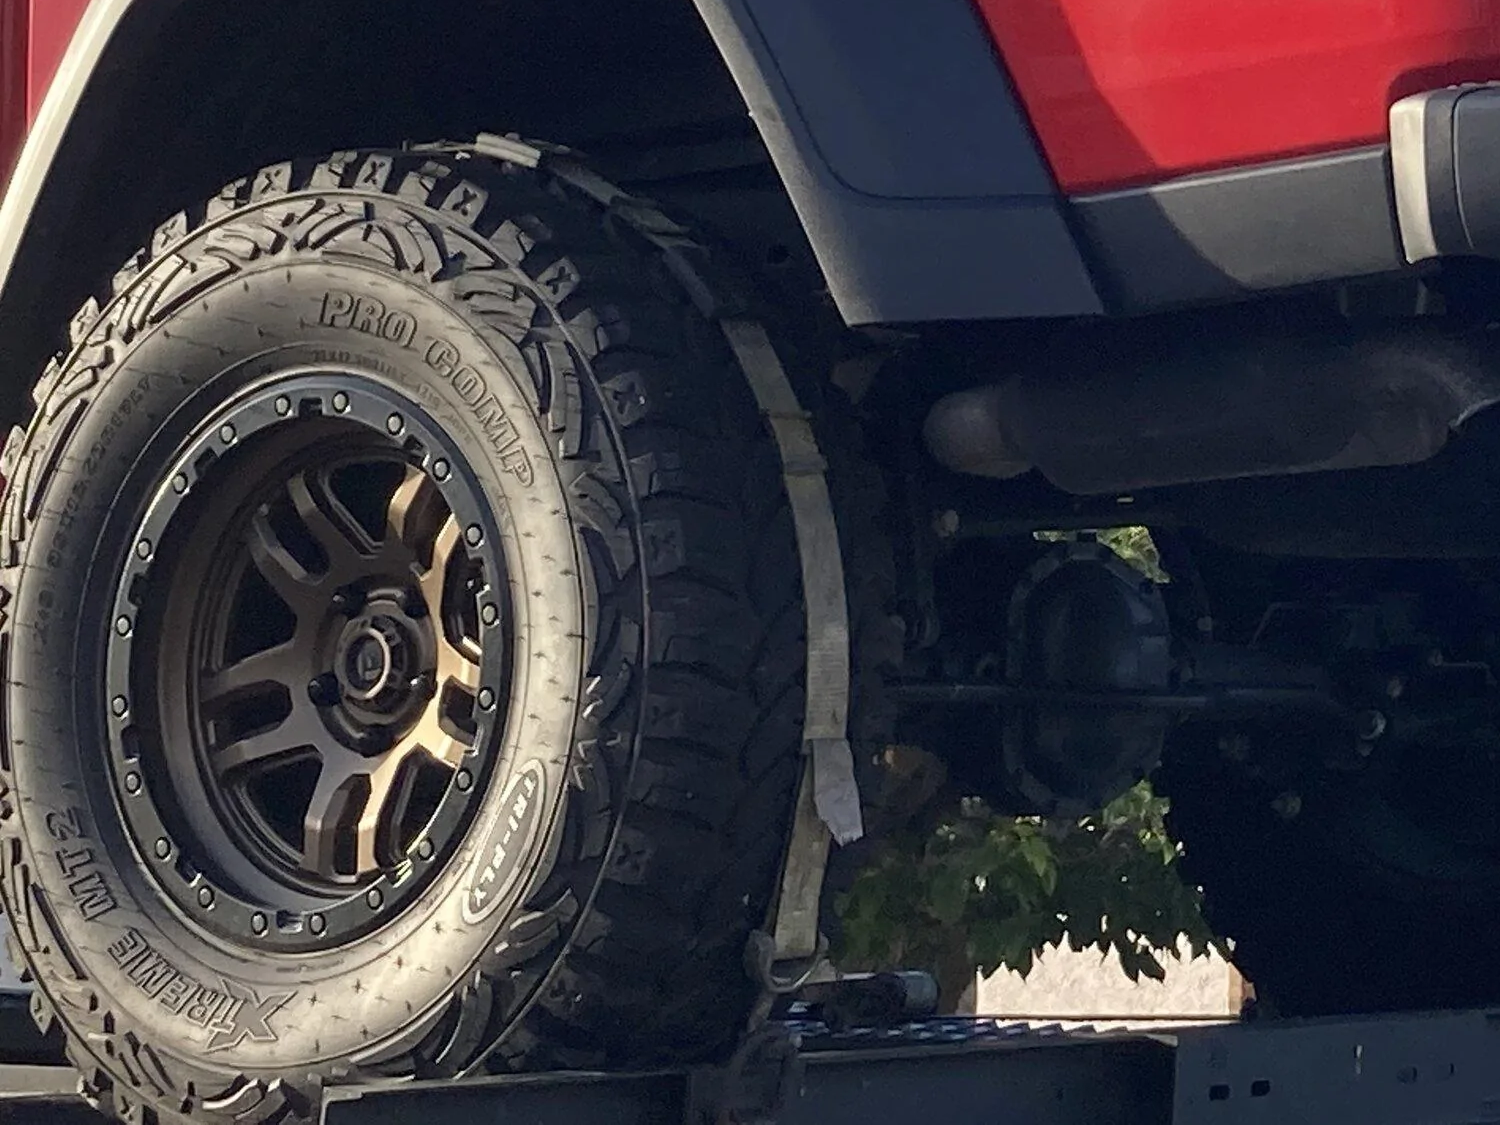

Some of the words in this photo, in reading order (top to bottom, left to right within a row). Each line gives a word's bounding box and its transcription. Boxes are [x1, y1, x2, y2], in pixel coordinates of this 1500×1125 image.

[319, 290, 417, 350] PRO
[423, 337, 537, 488] COMP
[43, 804, 115, 922] MT2
[468, 774, 539, 909] TRI-PLY
[107, 925, 299, 1052] XTREME
